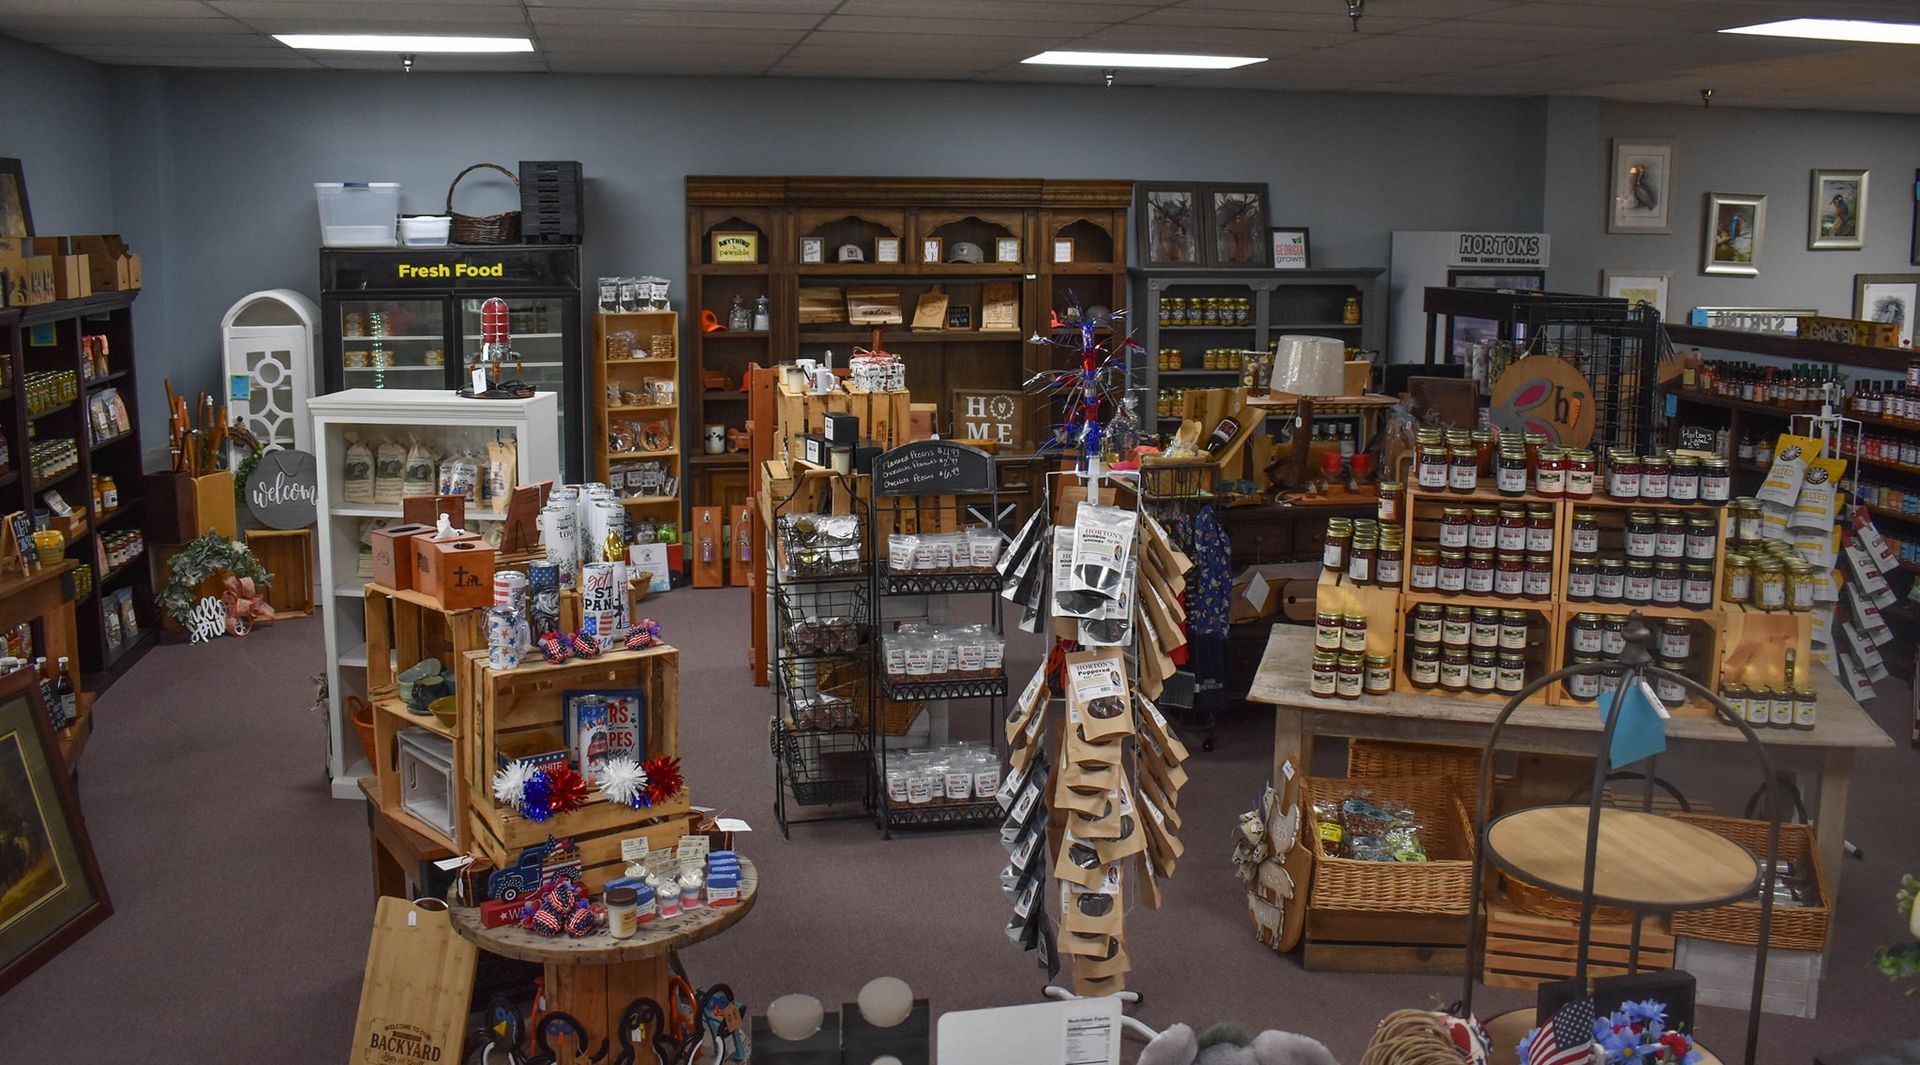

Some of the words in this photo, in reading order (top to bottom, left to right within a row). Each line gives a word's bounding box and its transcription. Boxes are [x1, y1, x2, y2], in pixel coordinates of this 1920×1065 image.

[1459, 234, 1540, 256] HORTONS
[1275, 256, 1305, 264] grown
[398, 263, 451, 278] Fresh
[455, 262, 503, 277] Food
[253, 471, 319, 508] welcom
[1077, 667, 1111, 676] Peppered
[384, 1023, 411, 1032] WELCOME
[370, 1033, 441, 1062] BACKYARD
